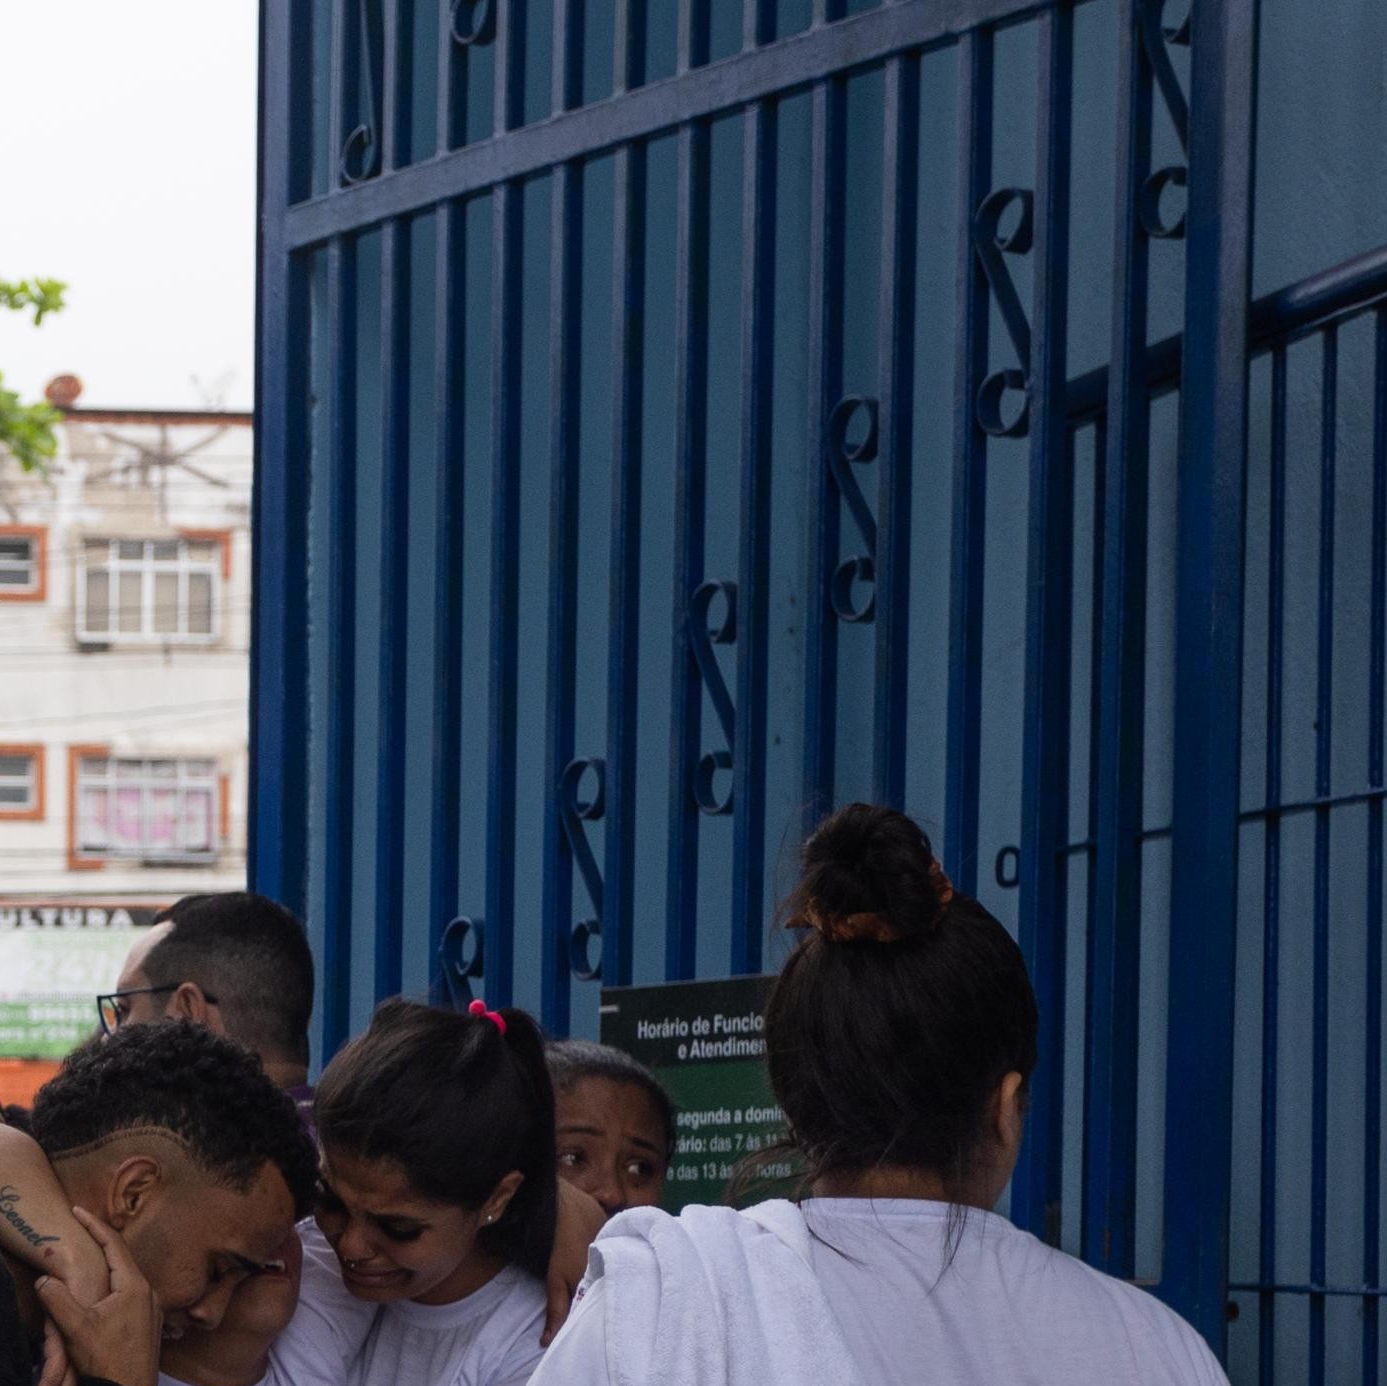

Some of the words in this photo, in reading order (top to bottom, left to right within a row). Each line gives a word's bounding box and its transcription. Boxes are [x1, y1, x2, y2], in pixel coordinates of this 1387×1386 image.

[637, 1017, 688, 1039] Horário
[692, 1016, 709, 1035] de
[714, 1012, 764, 1034] Funcio
[677, 1044, 688, 1059] e
[689, 1038, 768, 1059] Atendimen
[676, 1107, 731, 1129] segunda
[734, 1111, 743, 1123] a
[675, 1136, 707, 1154] ário:
[709, 1135, 732, 1151] das
[735, 1134, 744, 1150] 7
[666, 1165, 674, 1181] e
[677, 1164, 699, 1181] das
[702, 1162, 717, 1181] 13
